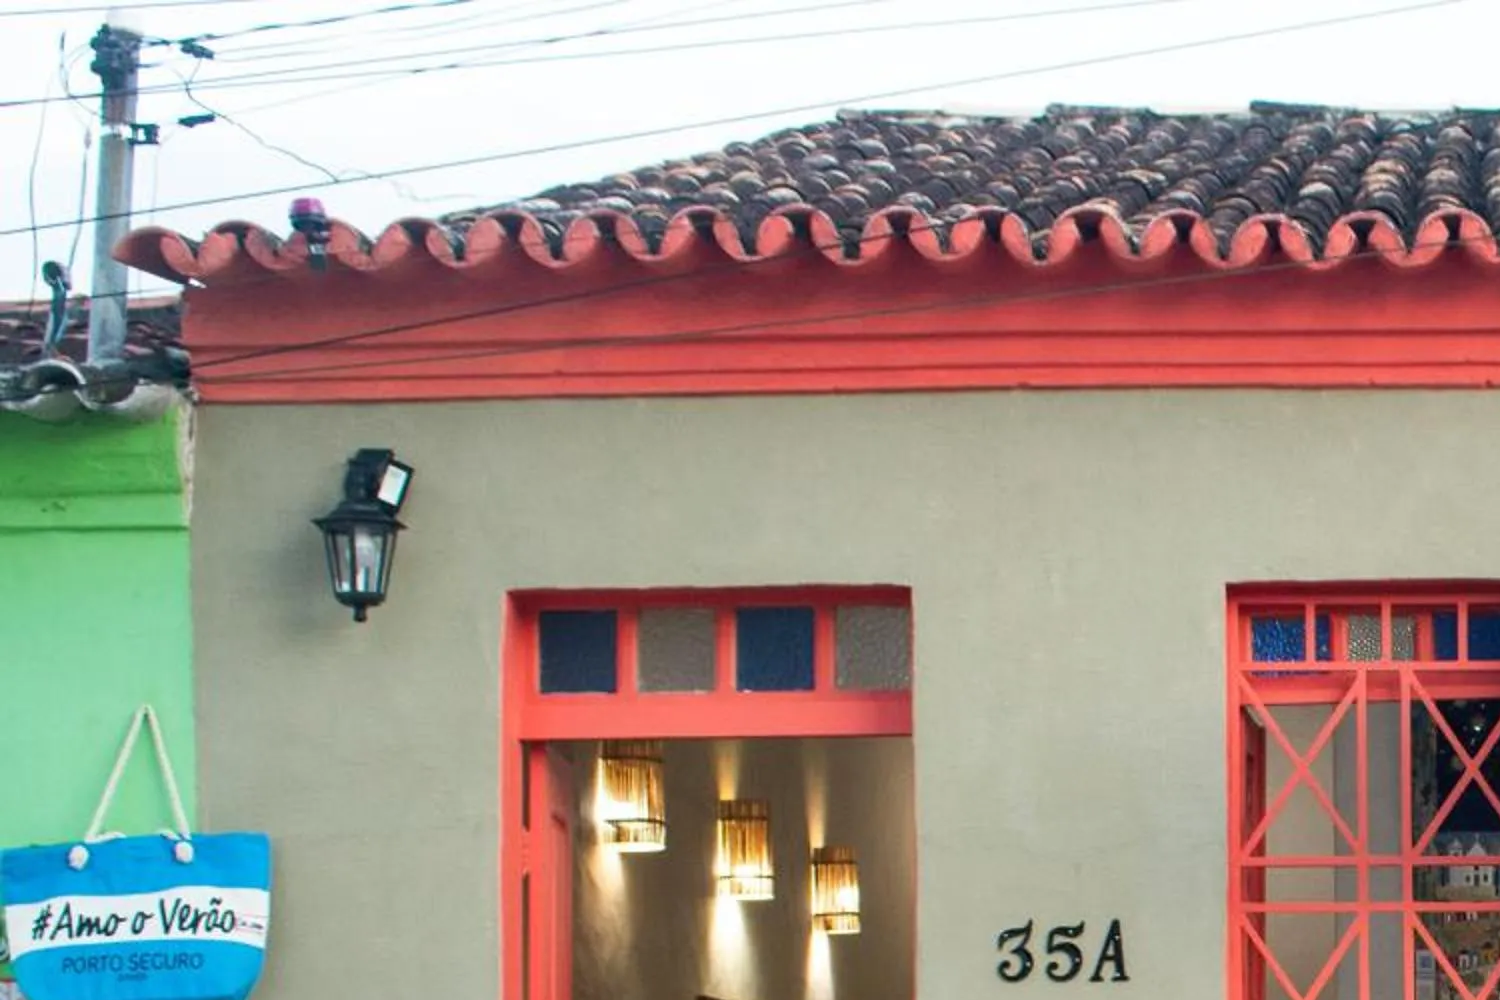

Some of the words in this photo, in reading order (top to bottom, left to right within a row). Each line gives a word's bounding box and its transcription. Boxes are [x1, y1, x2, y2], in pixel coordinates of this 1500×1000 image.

[32, 902, 127, 940] #Amo
[131, 911, 153, 935] o
[159, 897, 236, 935] Verão
[62, 955, 123, 974] PORTO
[128, 952, 205, 972] SEGURO
[997, 917, 1130, 982] 35A
